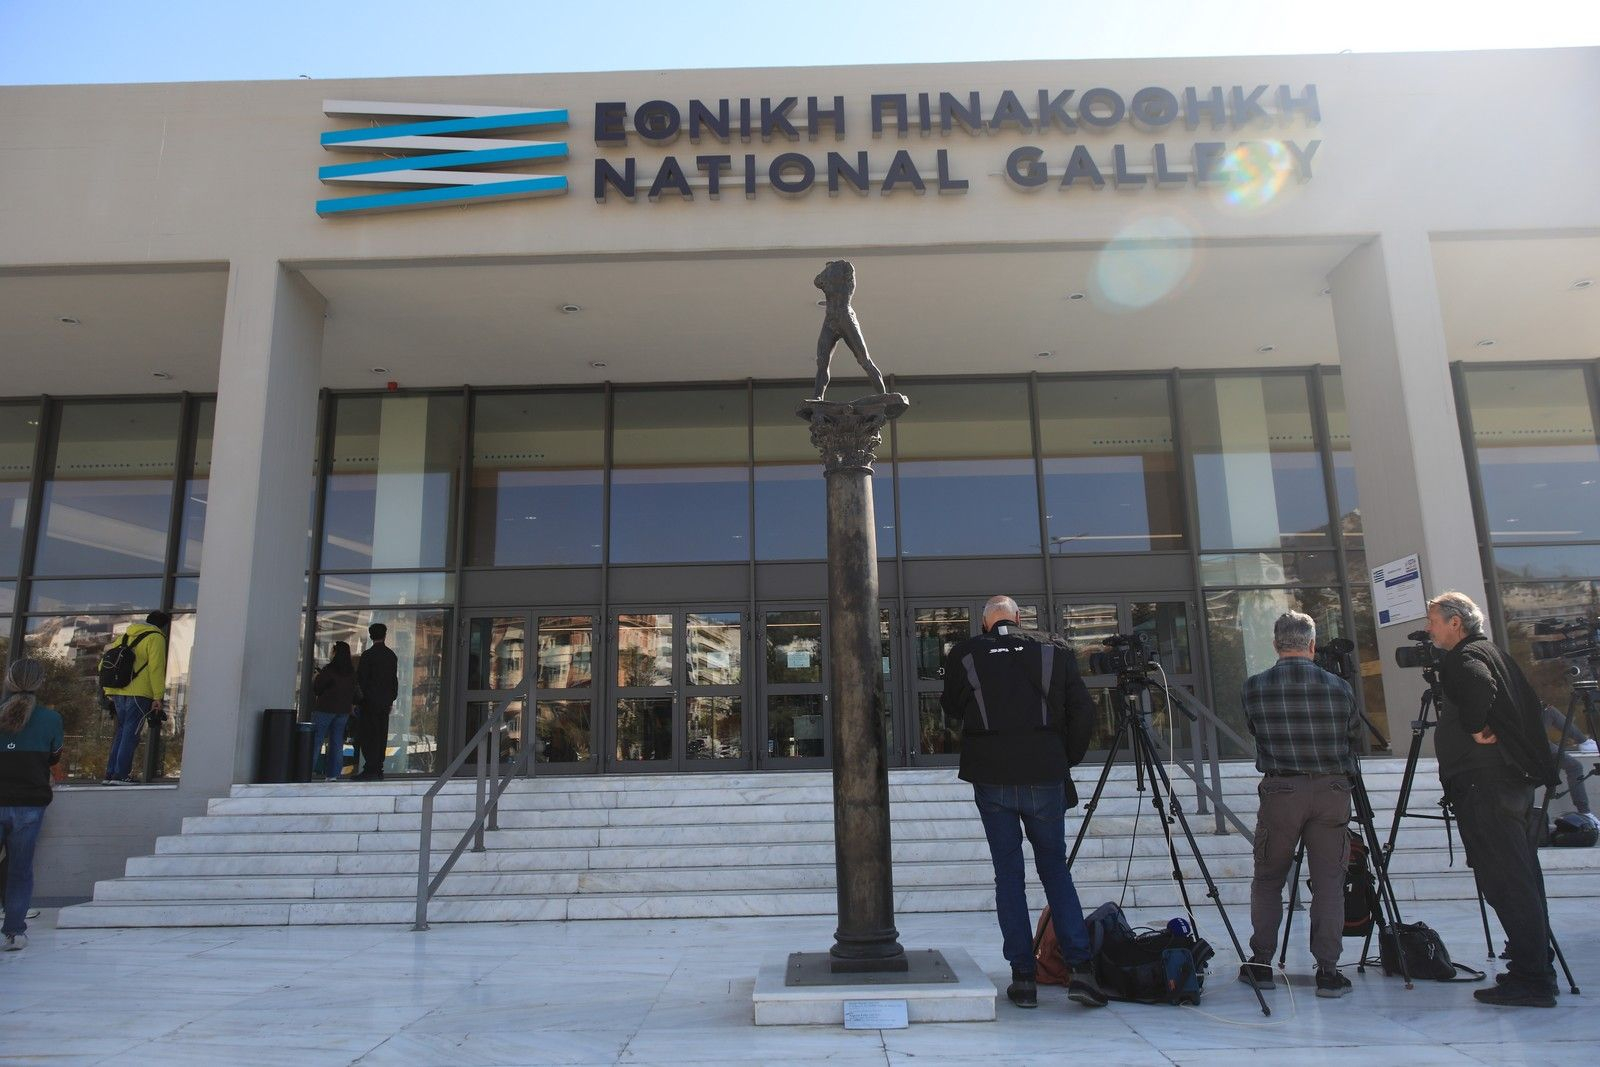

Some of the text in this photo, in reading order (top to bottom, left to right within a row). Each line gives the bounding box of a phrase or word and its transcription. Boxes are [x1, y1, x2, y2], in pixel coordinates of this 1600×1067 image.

[594, 84, 1321, 146] ΕΘΝΙΚΗ ΠΙΝΑΚΟΘΗΚΗ
[594, 139, 1322, 203] NATIONAL GALLEY
